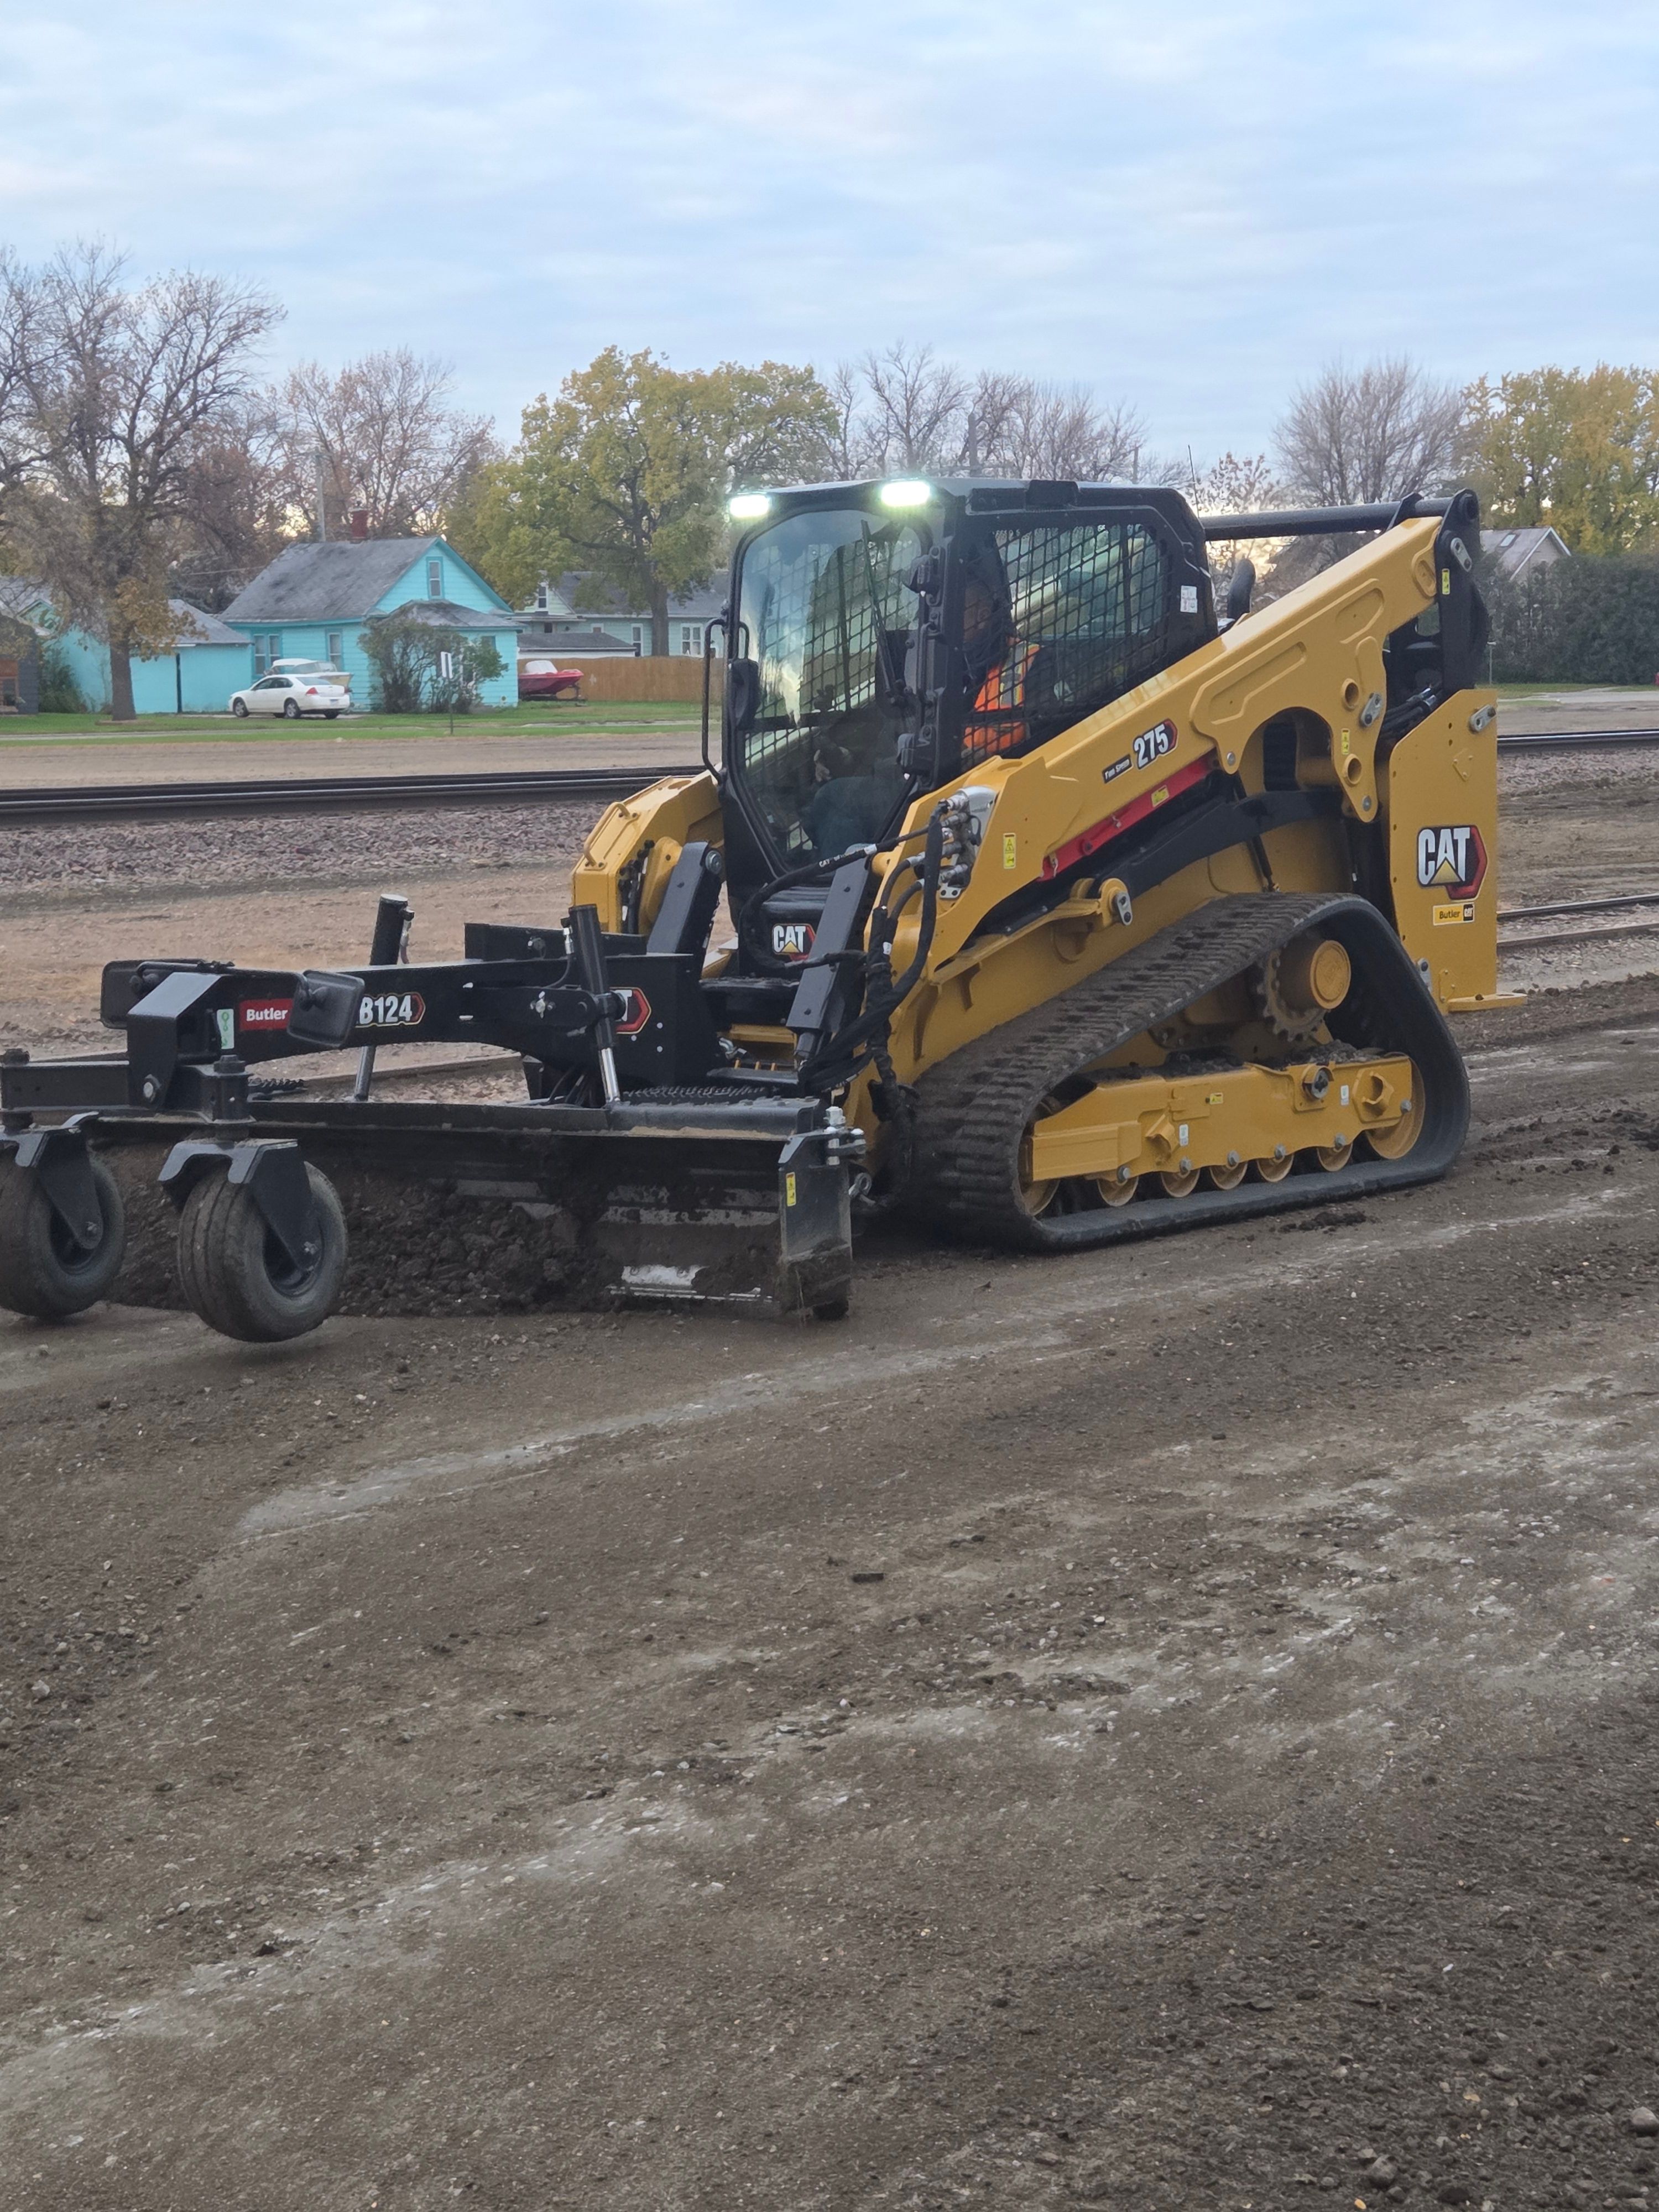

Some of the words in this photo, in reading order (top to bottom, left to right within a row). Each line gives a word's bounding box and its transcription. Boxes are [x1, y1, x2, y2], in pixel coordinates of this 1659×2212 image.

[1134, 723, 1168, 768] 275
[1418, 827, 1470, 885] CAT
[1439, 911, 1460, 919] Butler
[774, 925, 806, 953] CAT
[247, 1008, 288, 1021] Butler
[357, 995, 413, 1024] B124
